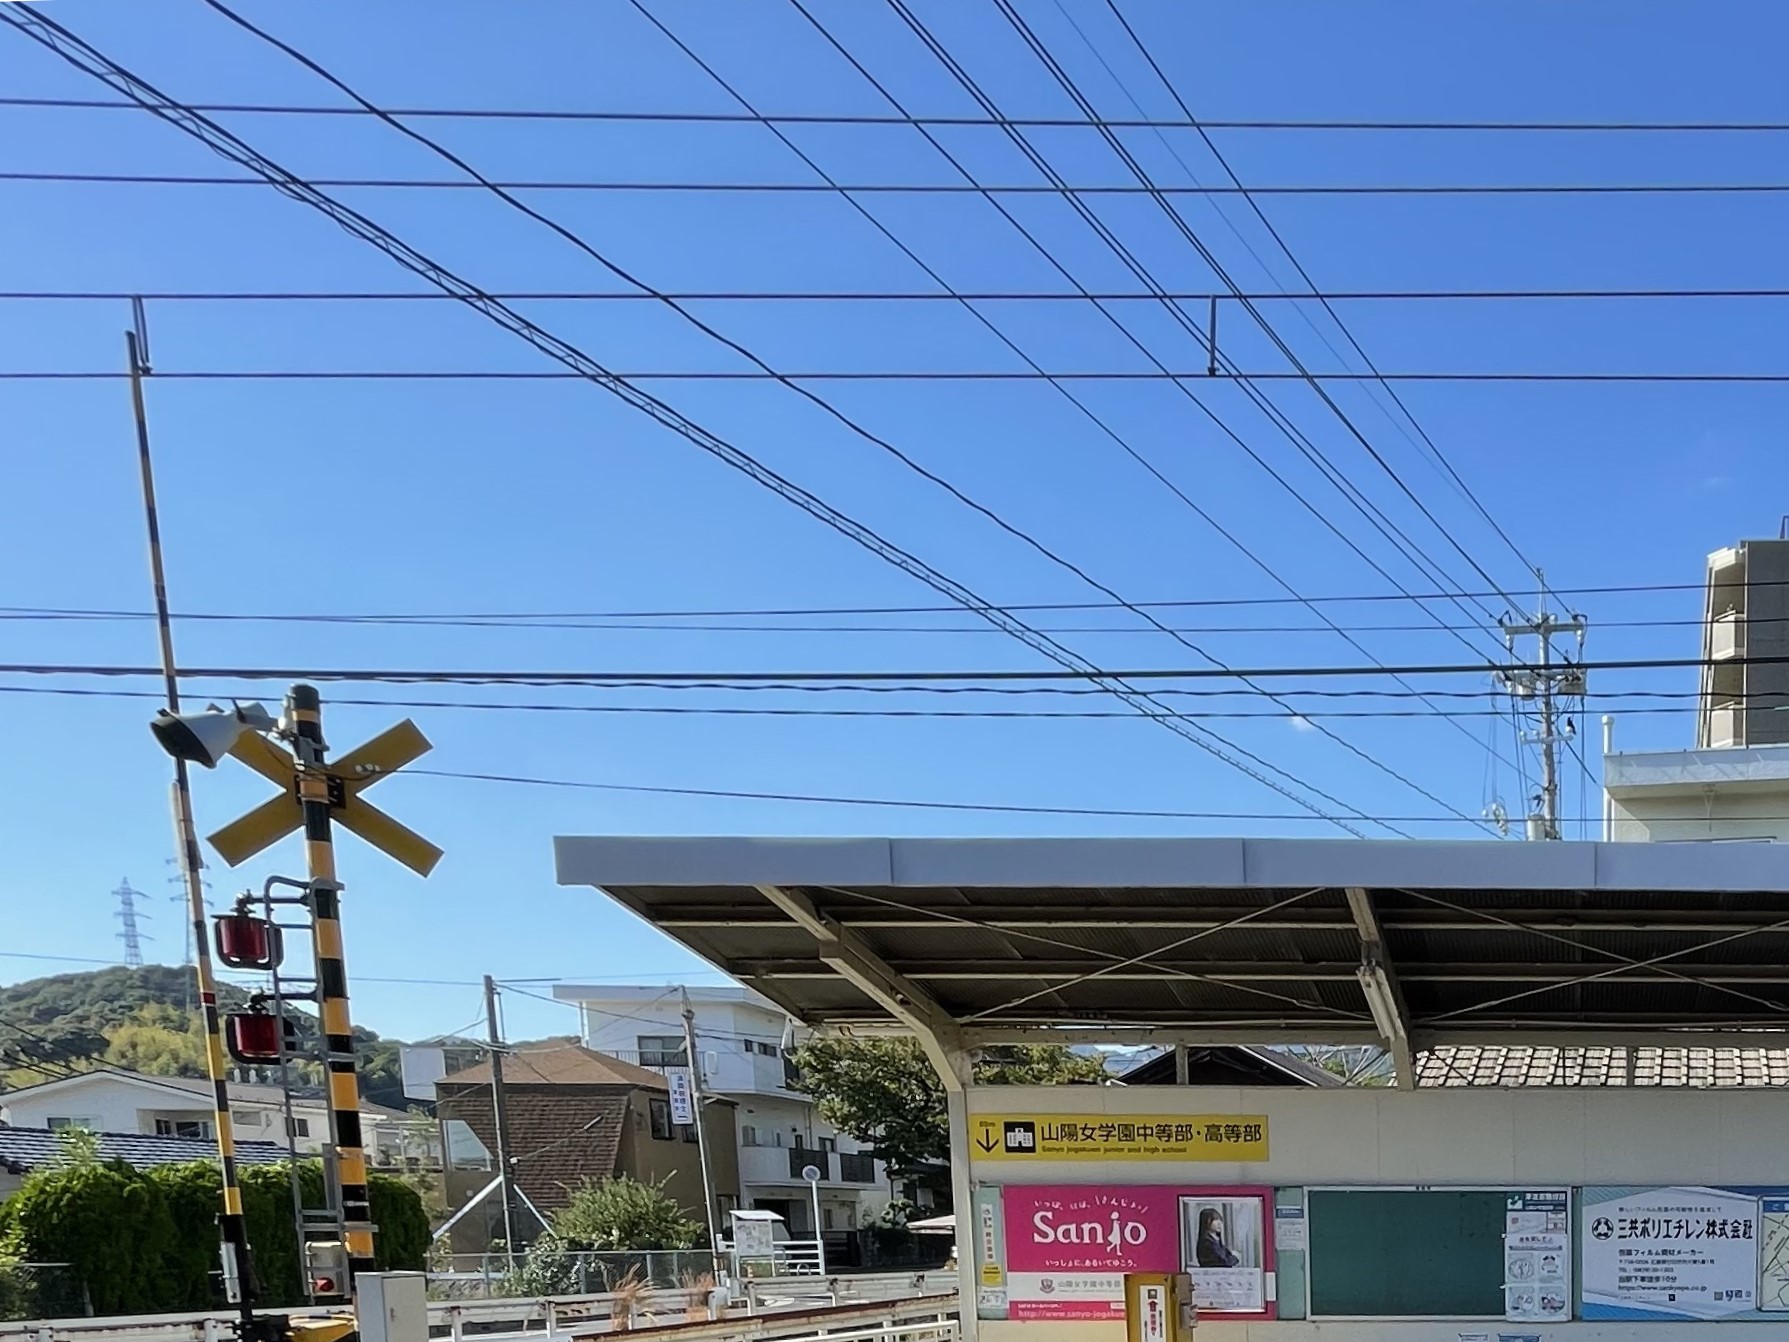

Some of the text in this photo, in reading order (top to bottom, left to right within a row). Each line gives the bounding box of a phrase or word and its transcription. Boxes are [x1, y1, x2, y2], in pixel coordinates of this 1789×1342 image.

[1041, 1123, 1262, 1142] 山陽女学園中等部・高等部
[1033, 1210, 1147, 1256] Sanjo
[1618, 1218, 1753, 1240] 三共ポリエチレン株式会社
